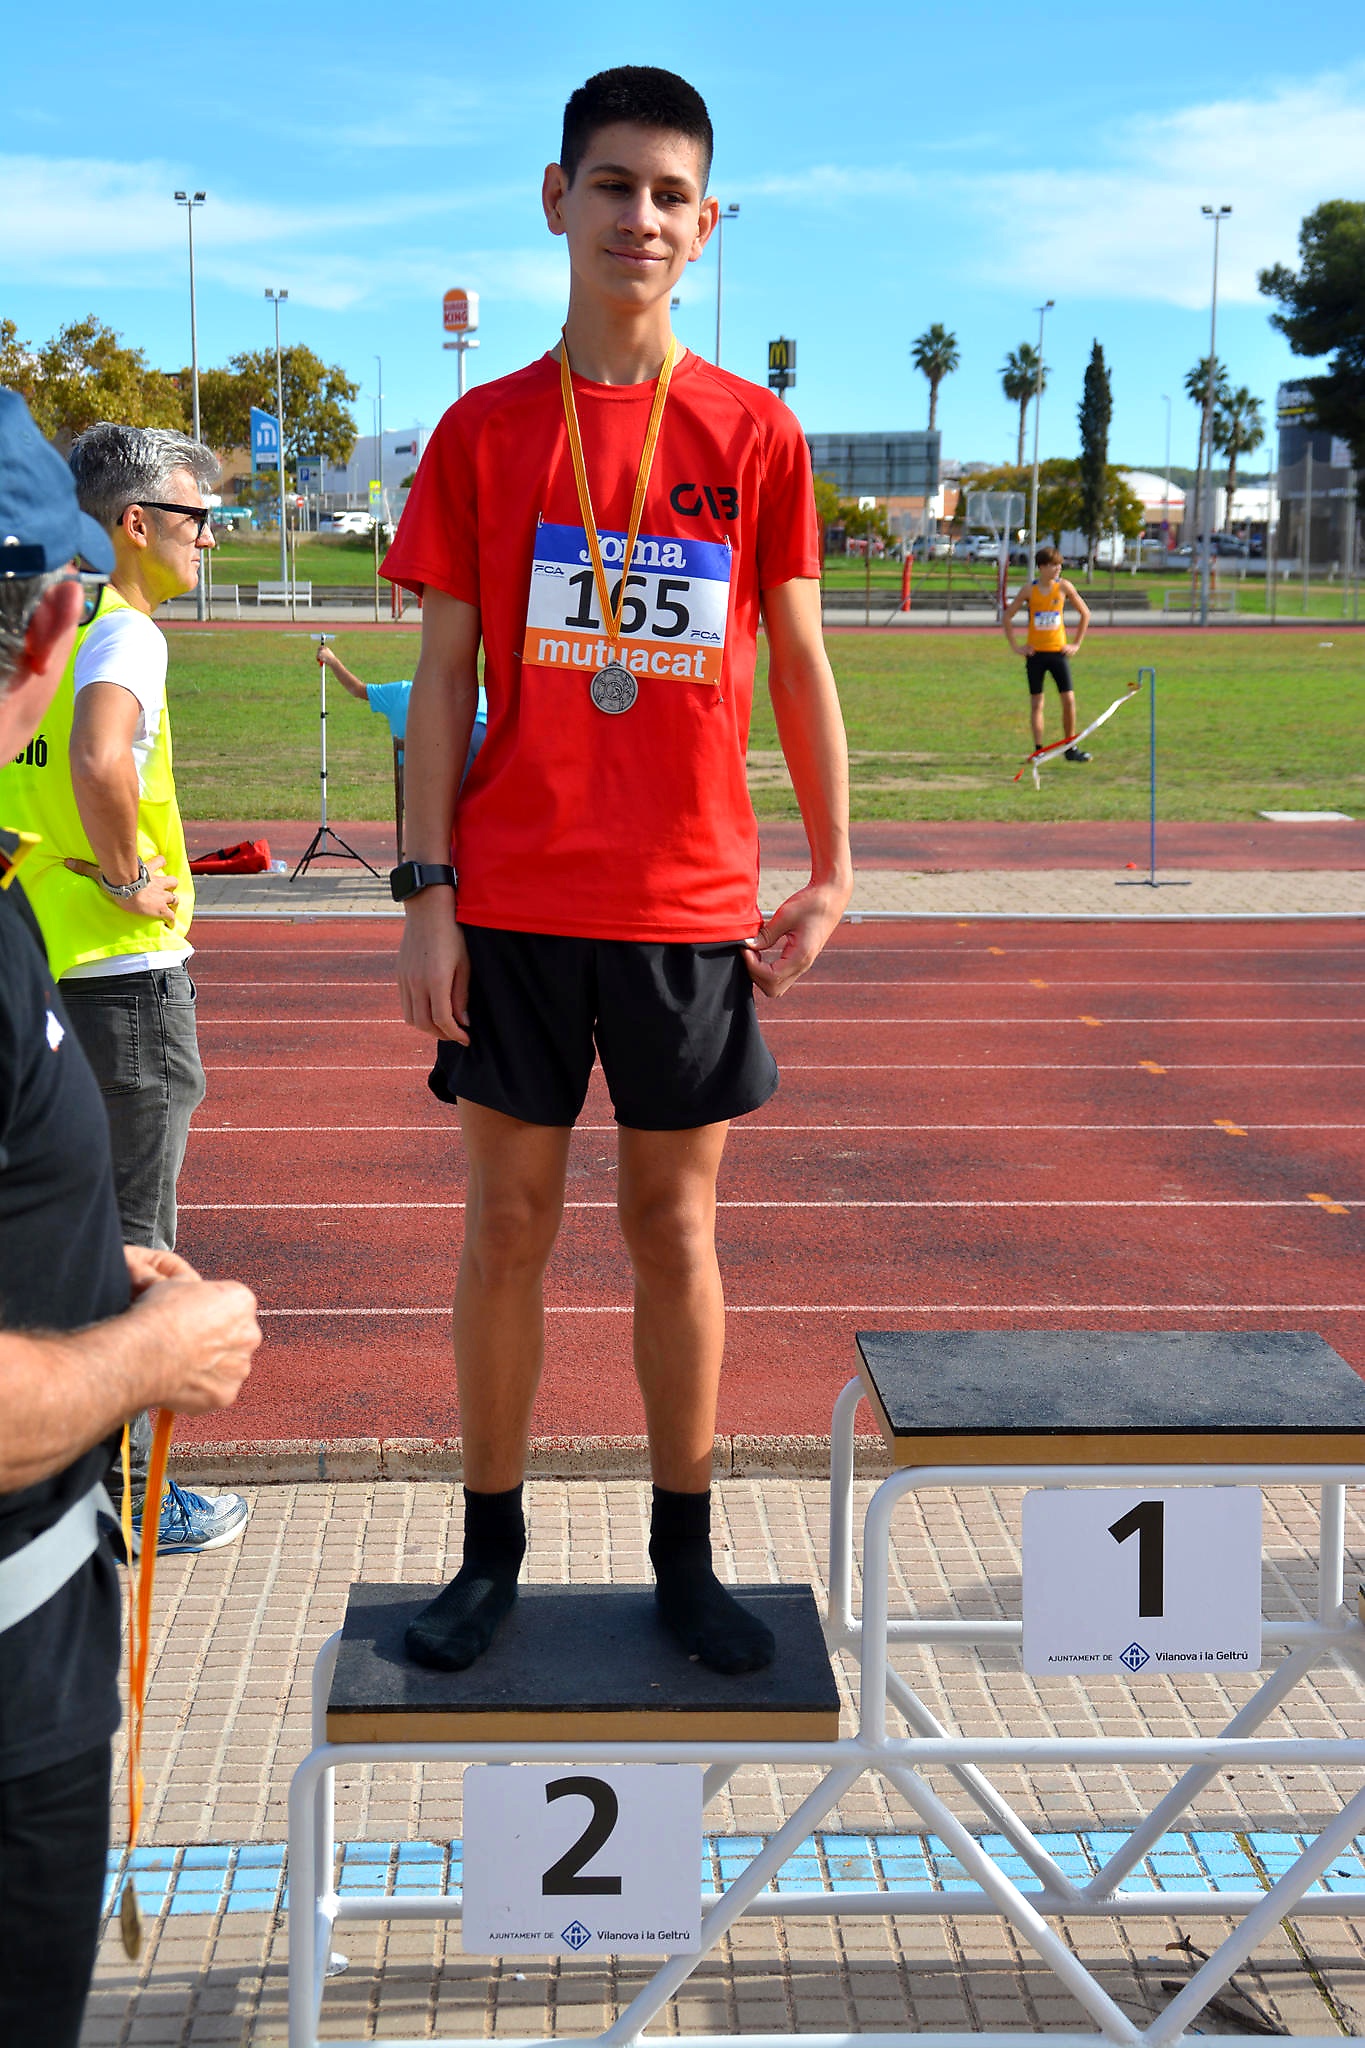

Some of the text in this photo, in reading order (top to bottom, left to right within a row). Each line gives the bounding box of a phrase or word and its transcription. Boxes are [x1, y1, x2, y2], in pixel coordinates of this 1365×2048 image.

[444, 310, 468, 323] KING
[534, 564, 564, 575] FCA
[565, 570, 690, 637] 165
[690, 630, 721, 640] FCA
[537, 638, 707, 679] mutuacat
[1108, 1501, 1164, 1617] 1
[1048, 1654, 1100, 1663] AJUNTAMENT
[1103, 1654, 1113, 1662] DE
[1155, 1651, 1197, 1661] Vilanova
[1204, 1651, 1213, 1661] la
[1216, 1650, 1249, 1661] Geltrú
[542, 1776, 621, 1895] 2
[489, 1932, 541, 1940] AJUNTAMENT
[596, 1930, 638, 1940] Vilanova
[646, 1930, 655, 1940] la
[658, 1930, 690, 1940] Geltrú
